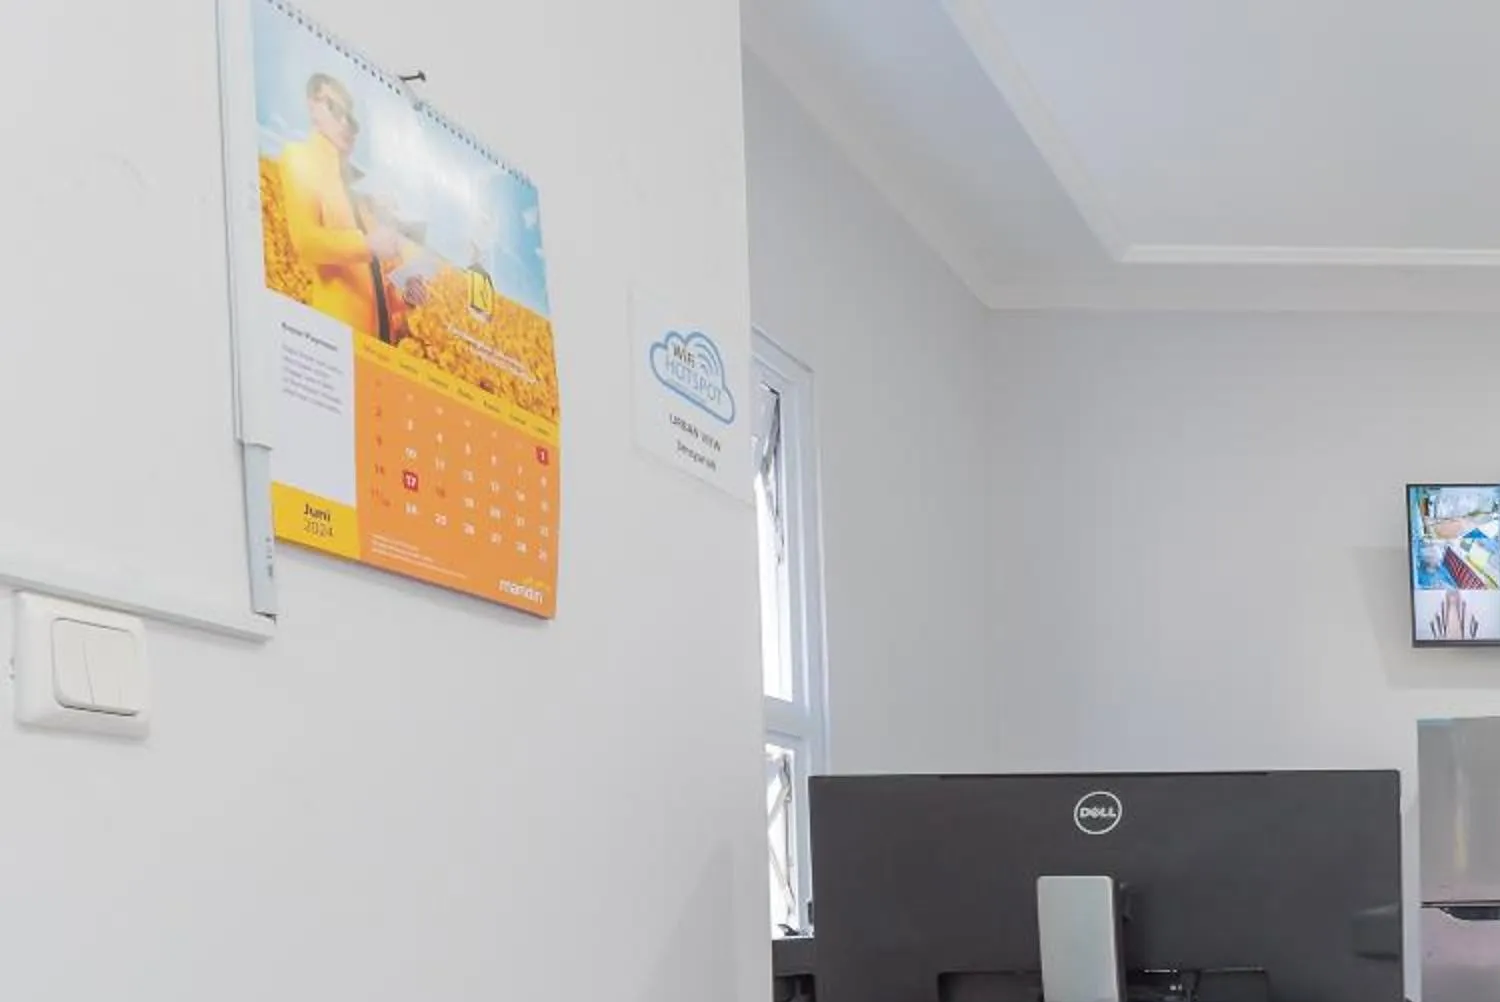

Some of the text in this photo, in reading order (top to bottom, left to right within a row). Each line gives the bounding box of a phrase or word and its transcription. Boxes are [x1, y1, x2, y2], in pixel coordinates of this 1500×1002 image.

[665, 353, 722, 404] HOTSPOT
[405, 474, 416, 487] 17
[303, 503, 331, 522] Juni
[303, 519, 334, 538] 2024
[1080, 806, 1116, 818] DELL
